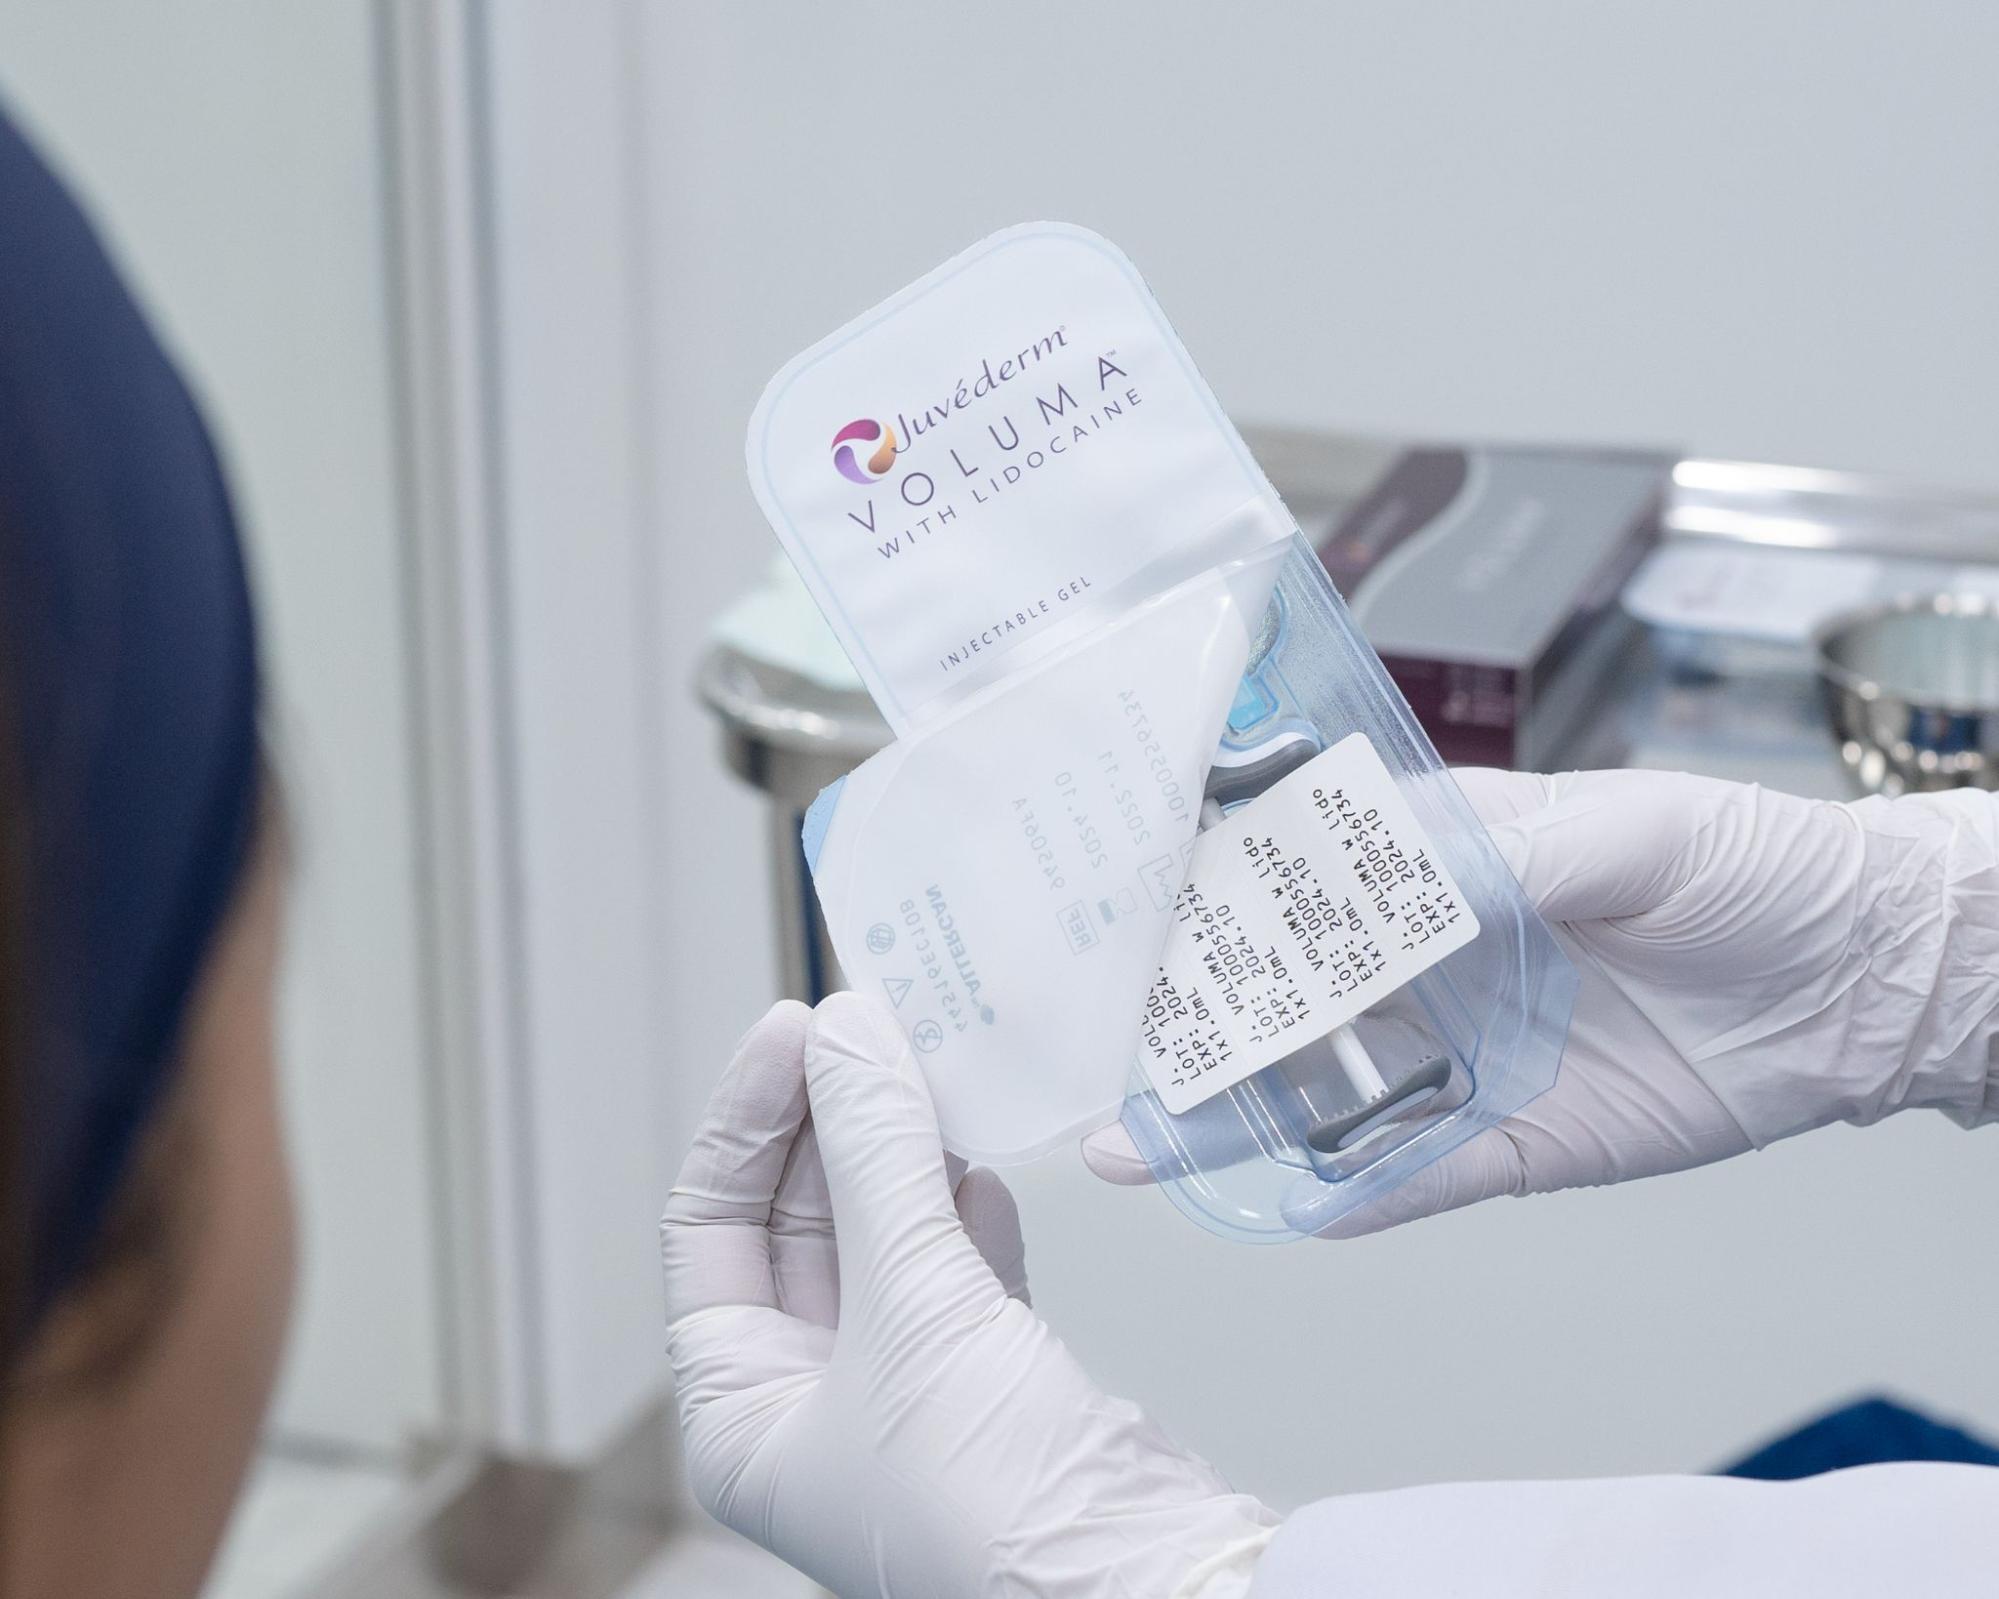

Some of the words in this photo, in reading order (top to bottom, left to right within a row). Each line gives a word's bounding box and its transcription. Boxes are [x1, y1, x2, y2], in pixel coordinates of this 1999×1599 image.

[877, 505, 957, 559] WITH
[972, 388, 1143, 504] LIDOCAINE
[940, 600, 1049, 671] INJECTABLE
[1057, 576, 1091, 602] GEL
[1331, 789, 1398, 894] 1000556734
[1361, 808, 1415, 883] 2024.10
[1261, 835, 1327, 945] 1000556734
[1291, 857, 1343, 932] 2024.10
[1353, 857, 1396, 924] VOLUMA
[1411, 849, 1461, 923] 1x1.0mL
[1416, 891, 1446, 935] EXP:
[1181, 883, 1248, 988] 1000556734
[1216, 905, 1266, 978] 2024.10
[1282, 904, 1324, 972] VOLUMA
[1339, 896, 1386, 973] 1x1.0mL
[1400, 901, 1432, 944] LOT:
[1400, 931, 1415, 950] J.
[1203, 951, 1245, 1015] VOLUMA
[1264, 945, 1310, 1020] 1x1.0mL
[1328, 949, 1360, 992] LOT:
[1329, 980, 1342, 1000] J.
[1344, 940, 1373, 983] EXP:
[1186, 987, 1232, 1063] 1x1.0mL
[1249, 1025, 1263, 1042] J.
[1250, 996, 1279, 1038] LOT:
[1266, 987, 1296, 1029] EXP:
[1171, 1068, 1184, 1086] J.
[1173, 1038, 1202, 1080] LOT:
[1188, 1029, 1218, 1071] EXP:
